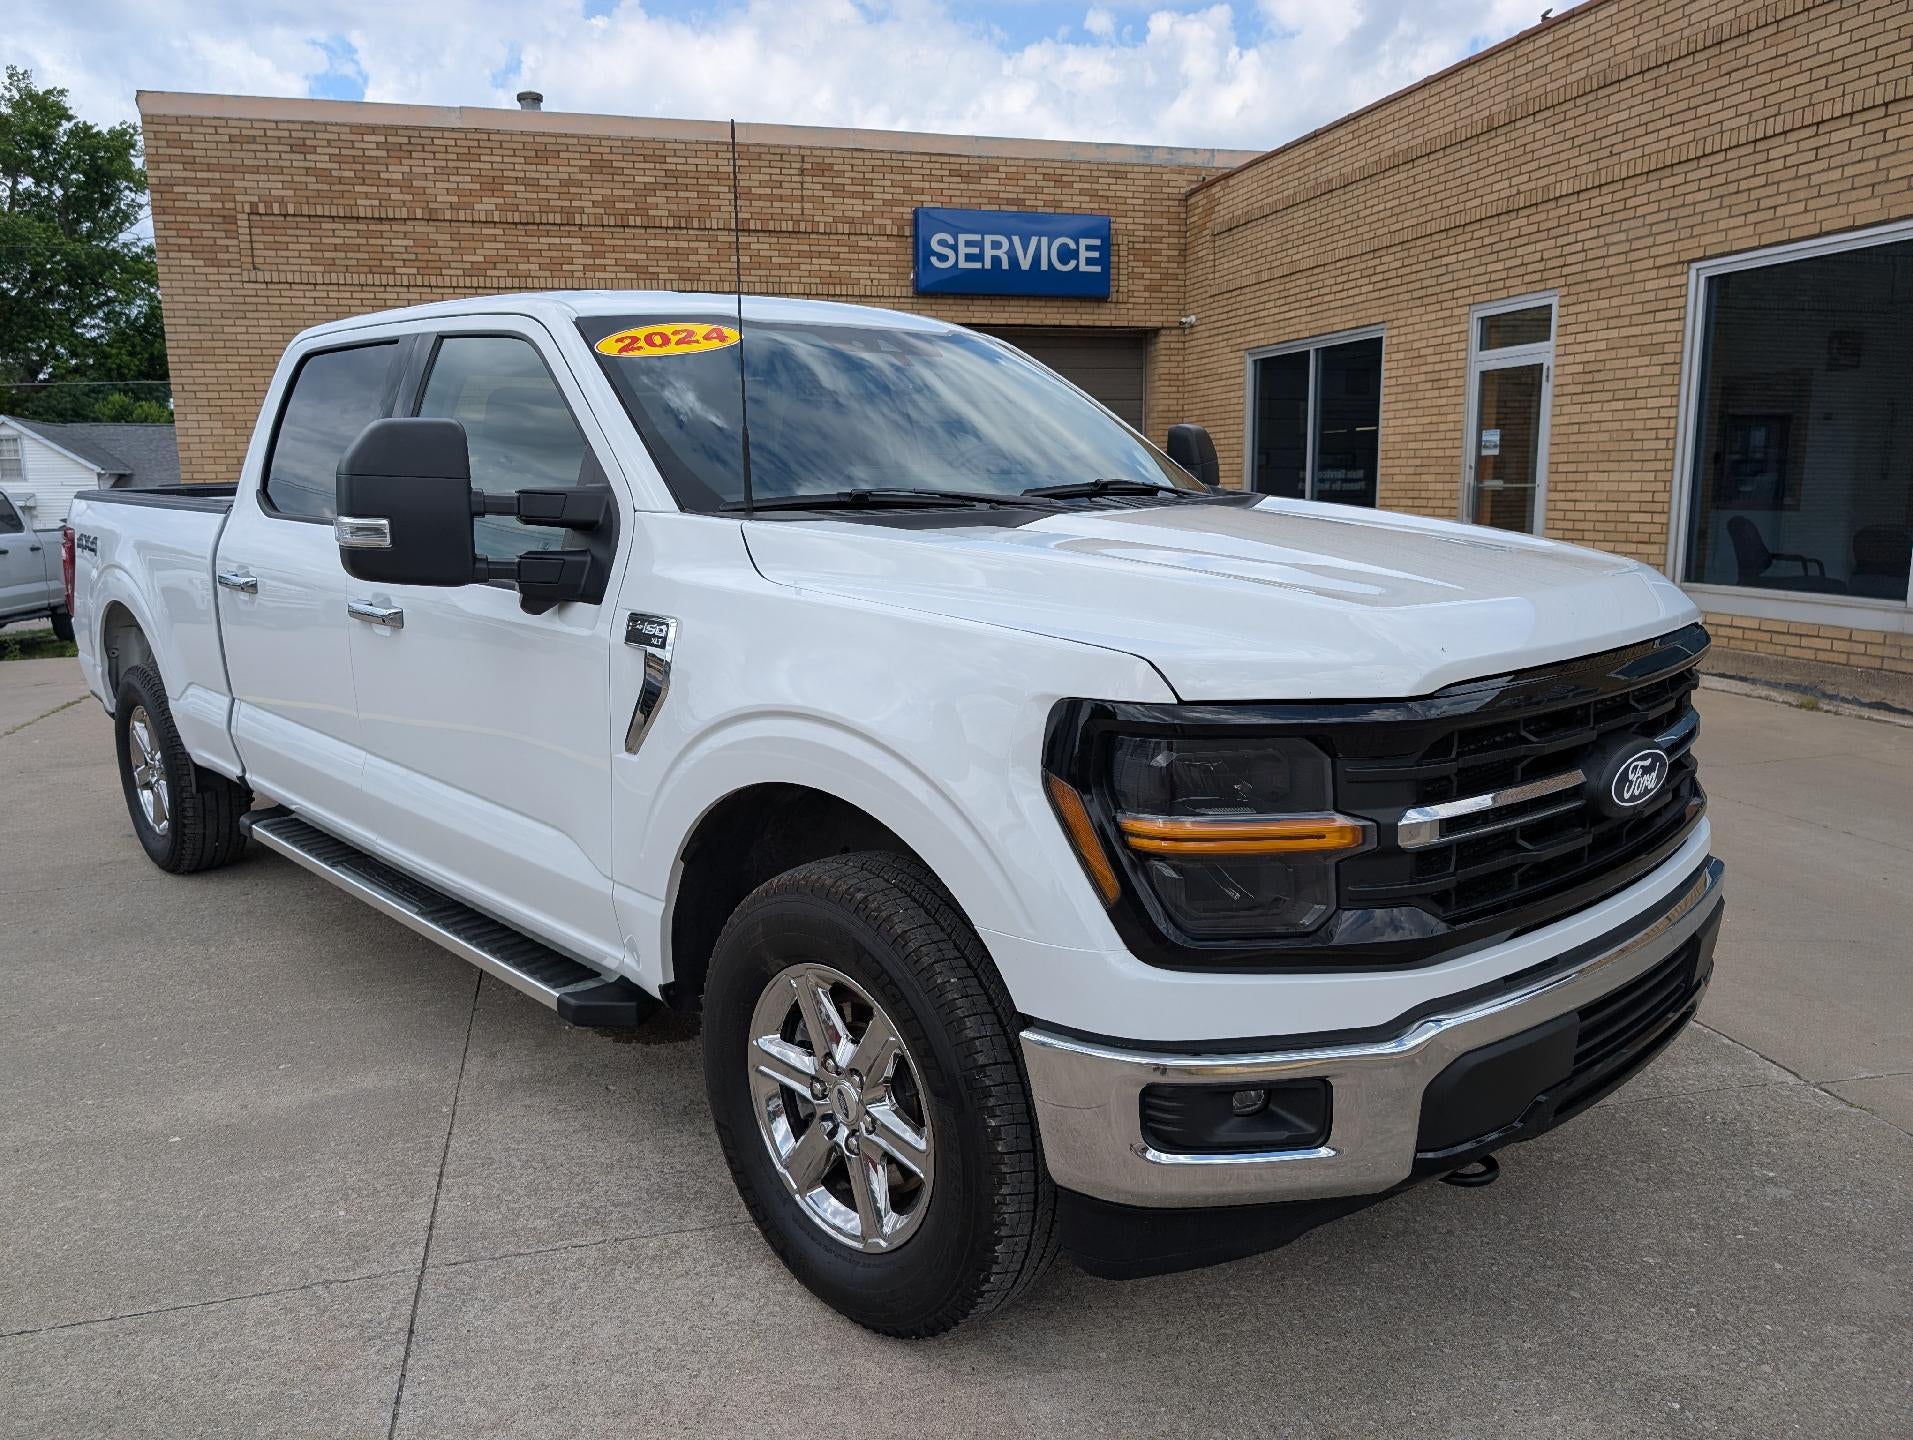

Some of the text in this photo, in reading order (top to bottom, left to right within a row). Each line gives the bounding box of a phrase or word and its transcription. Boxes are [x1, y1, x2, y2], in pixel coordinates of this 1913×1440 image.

[930, 232, 1101, 273] SERVICE
[615, 327, 729, 355] 2024
[1623, 757, 1660, 800] Ford
